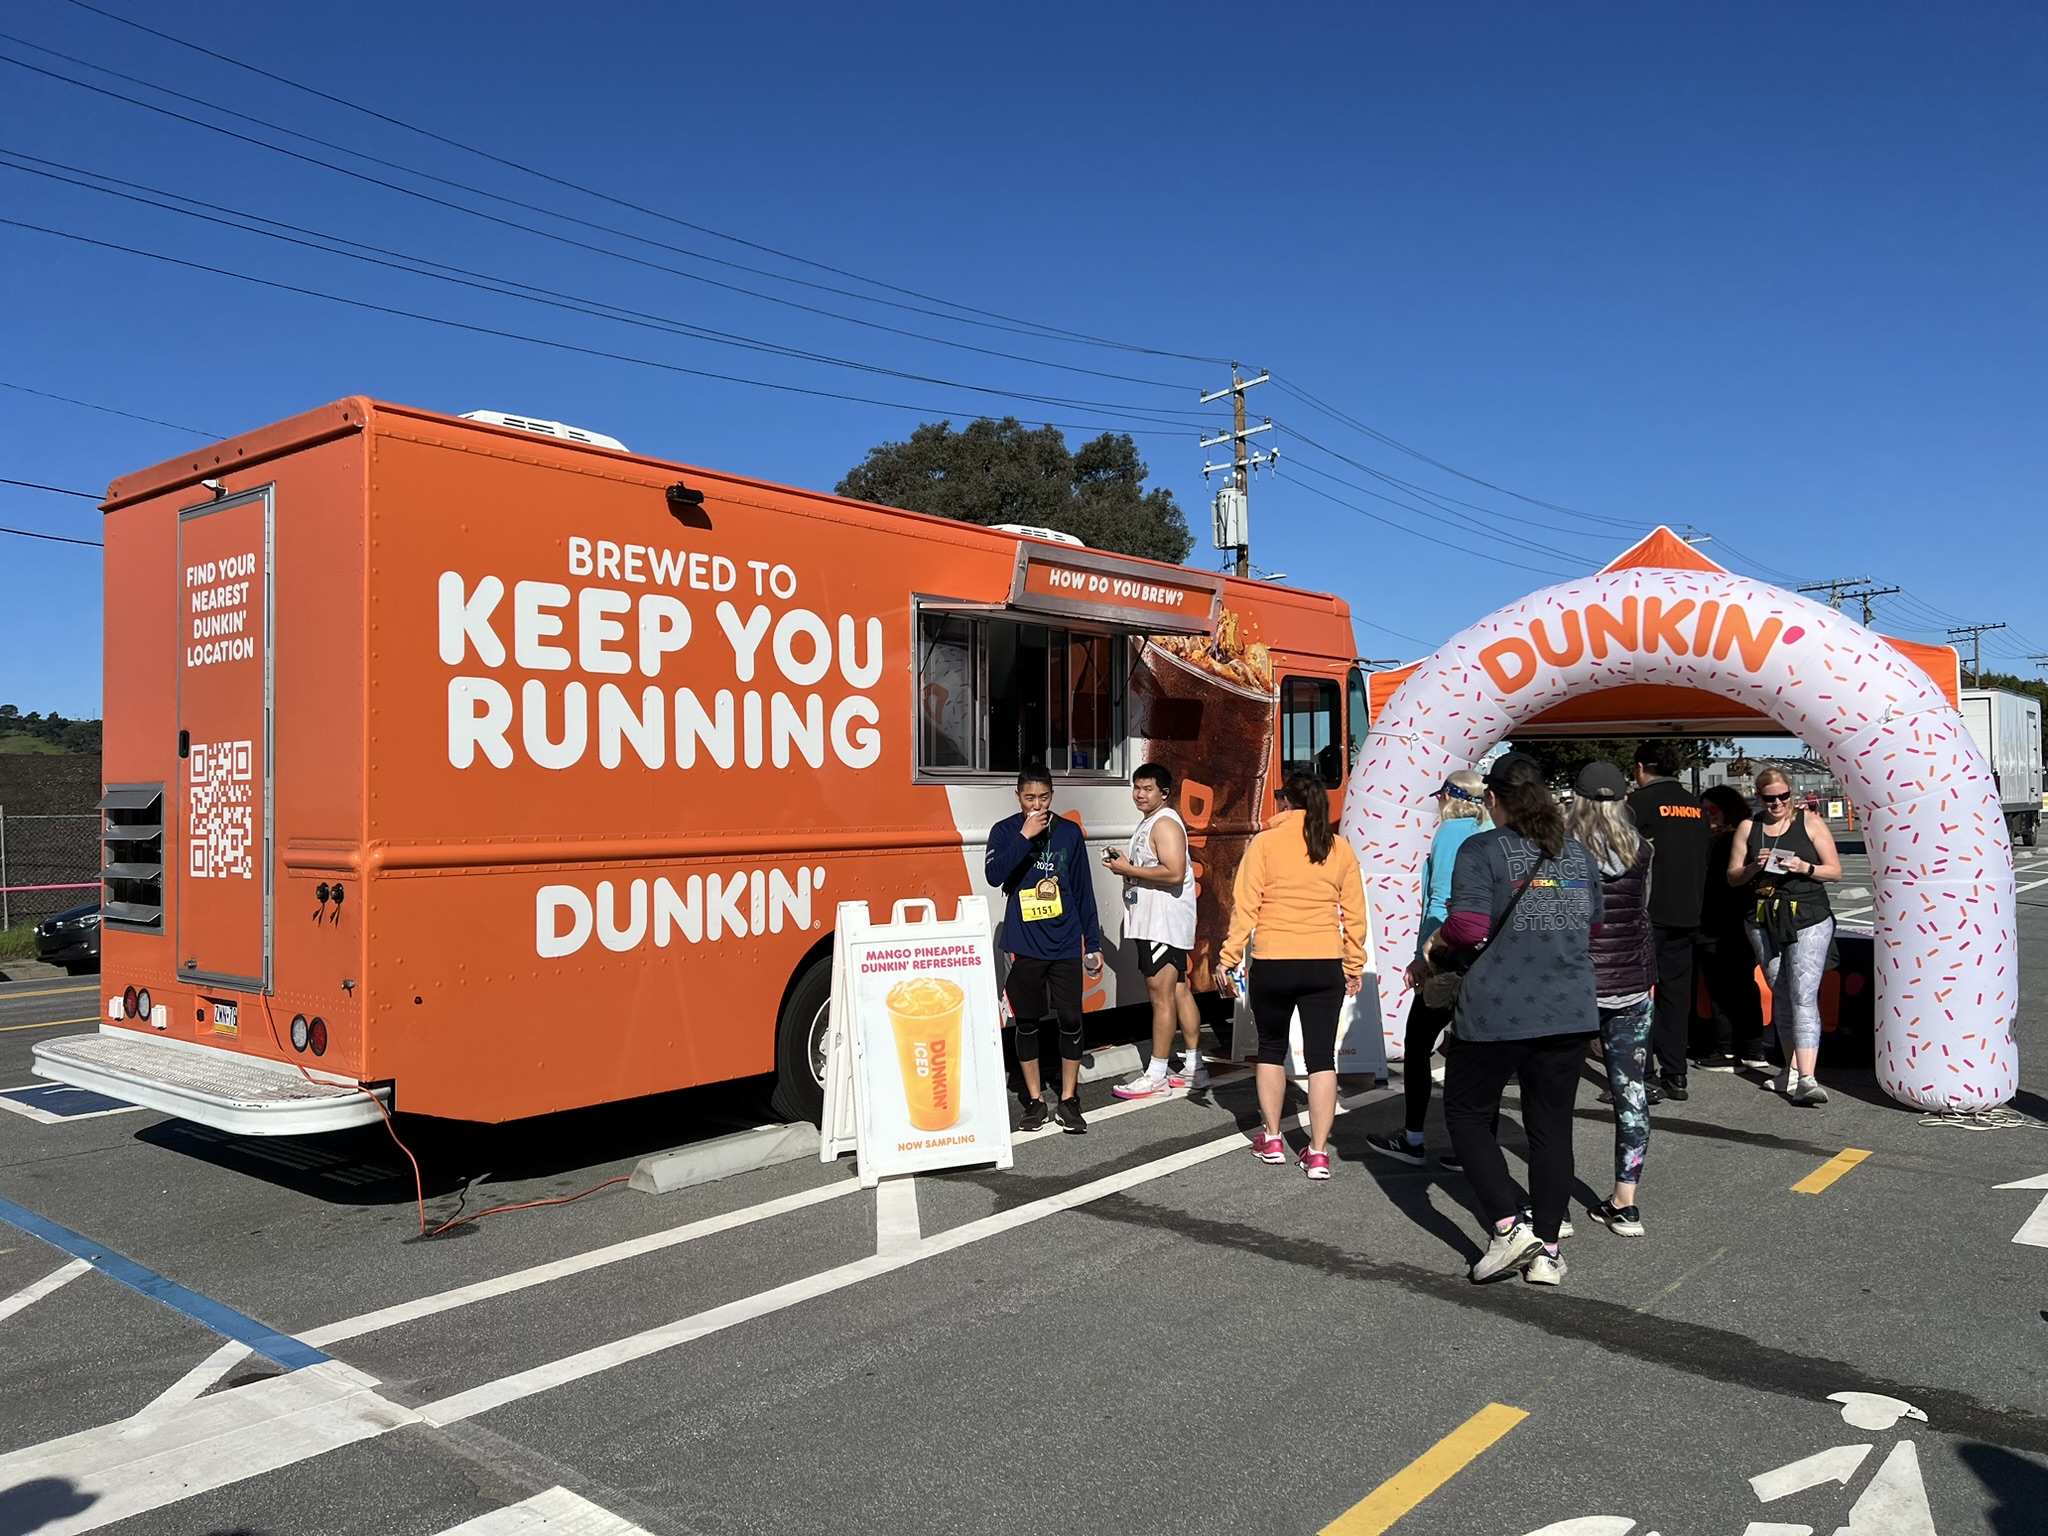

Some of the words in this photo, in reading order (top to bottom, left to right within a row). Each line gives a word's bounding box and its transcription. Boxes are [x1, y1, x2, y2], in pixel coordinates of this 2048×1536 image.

[186, 562, 217, 588] FIND
[218, 552, 256, 581] YOUR
[568, 536, 737, 592] BREWED
[747, 560, 797, 600] TO
[191, 582, 249, 614] NEAREST
[1049, 568, 1086, 590] HOW
[1088, 575, 1109, 594] DO
[1112, 578, 1141, 599] YOU
[1141, 585, 1184, 607] BREW?
[193, 609, 247, 640] DUNKIN'
[438, 570, 693, 678] KEEP
[715, 600, 883, 689] YOU
[187, 636, 254, 668] LOCATION
[1478, 595, 1806, 695] DUNKIN'
[447, 676, 881, 770] RUNNING
[536, 866, 826, 959] DUNKIN'
[1031, 905, 1053, 916] 1151
[861, 961, 909, 973] DUNKIN'
[912, 956, 982, 970] REFRESHERS
[866, 949, 912, 961] MANGO
[914, 945, 975, 958] PINEAPPLE
[913, 1041, 930, 1078] ICED
[930, 1039, 948, 1110] DUNKIN'
[897, 1140, 923, 1152] NOW
[925, 1134, 975, 1148] SAMPLING
